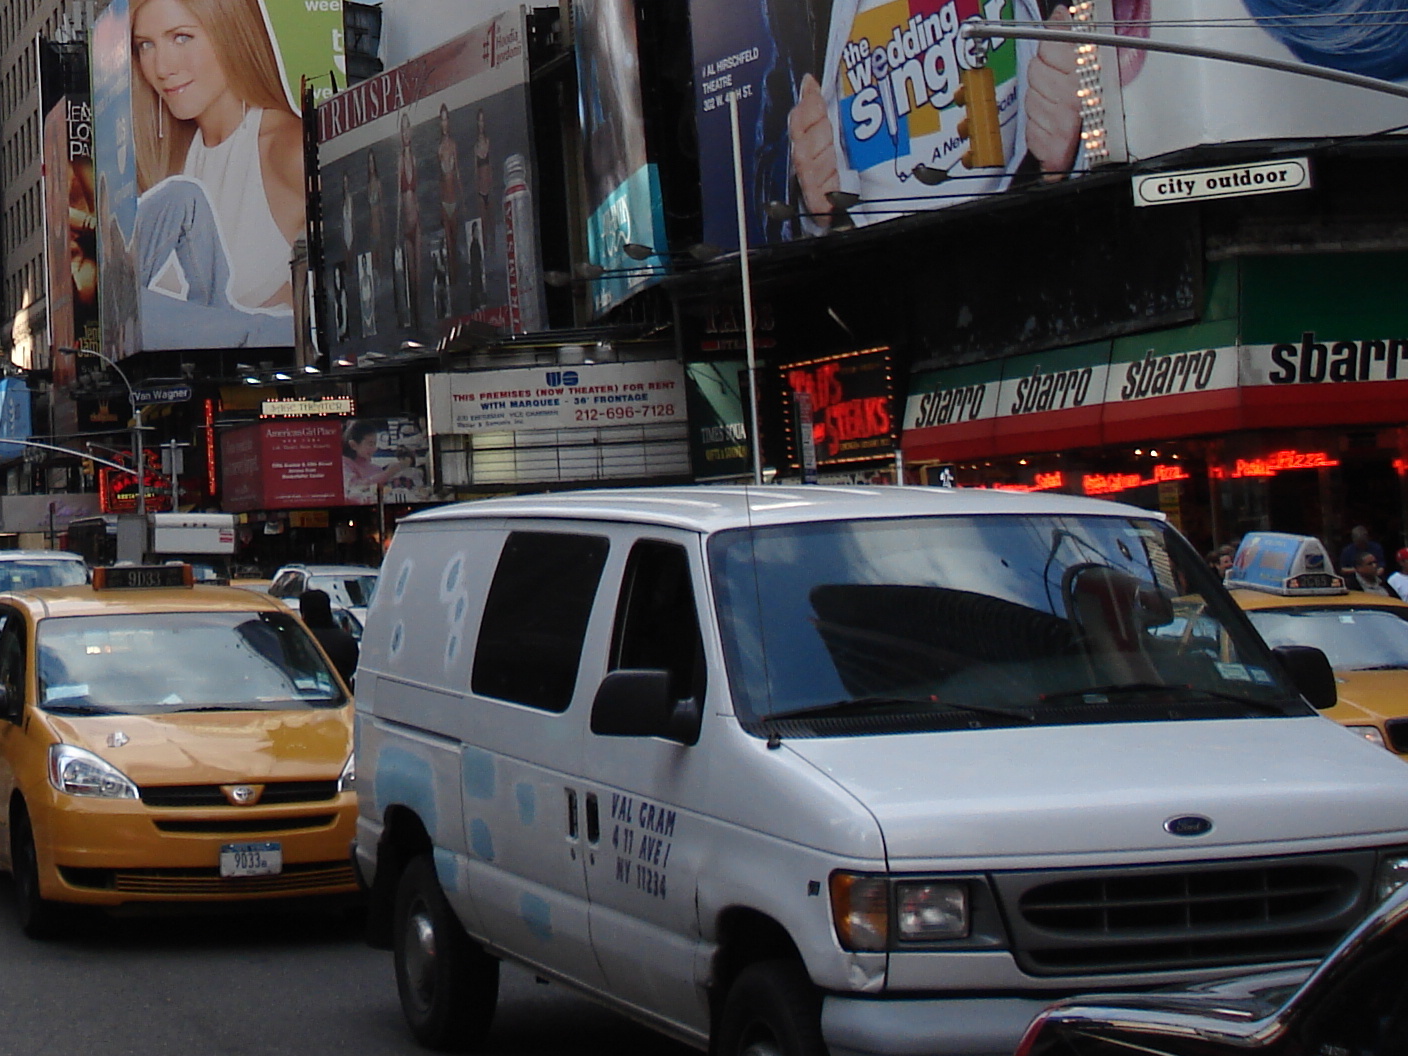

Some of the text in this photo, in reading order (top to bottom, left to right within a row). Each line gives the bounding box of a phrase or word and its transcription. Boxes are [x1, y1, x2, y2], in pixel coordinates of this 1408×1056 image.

[716, 47, 759, 73] HIRSCHFELD
[843, 37, 871, 70] the
[846, 0, 960, 95] wedding
[702, 74, 733, 95] THEATRE
[318, 69, 405, 145] TRIMSPA
[932, 146, 942, 163] A
[1157, 170, 1288, 195] city outdoor
[1269, 331, 1408, 384] sbarr
[134, 388, 188, 401] Van Wagner
[453, 381, 675, 402] THIS PREMISES (NOW THEATER) FOR RENT
[915, 348, 1217, 429] sbarro sbarro sbarro
[480, 401, 506, 410] WITH
[510, 398, 560, 408] MARQUEE
[594, 393, 649, 404] FRONTAGE
[575, 404, 675, 422] 212-696-7128
[1269, 450, 1339, 469] Pizza
[128, 571, 161, 587] 9D33
[612, 793, 633, 823] VAL
[638, 834, 663, 865] AVE
[616, 856, 631, 884] NY
